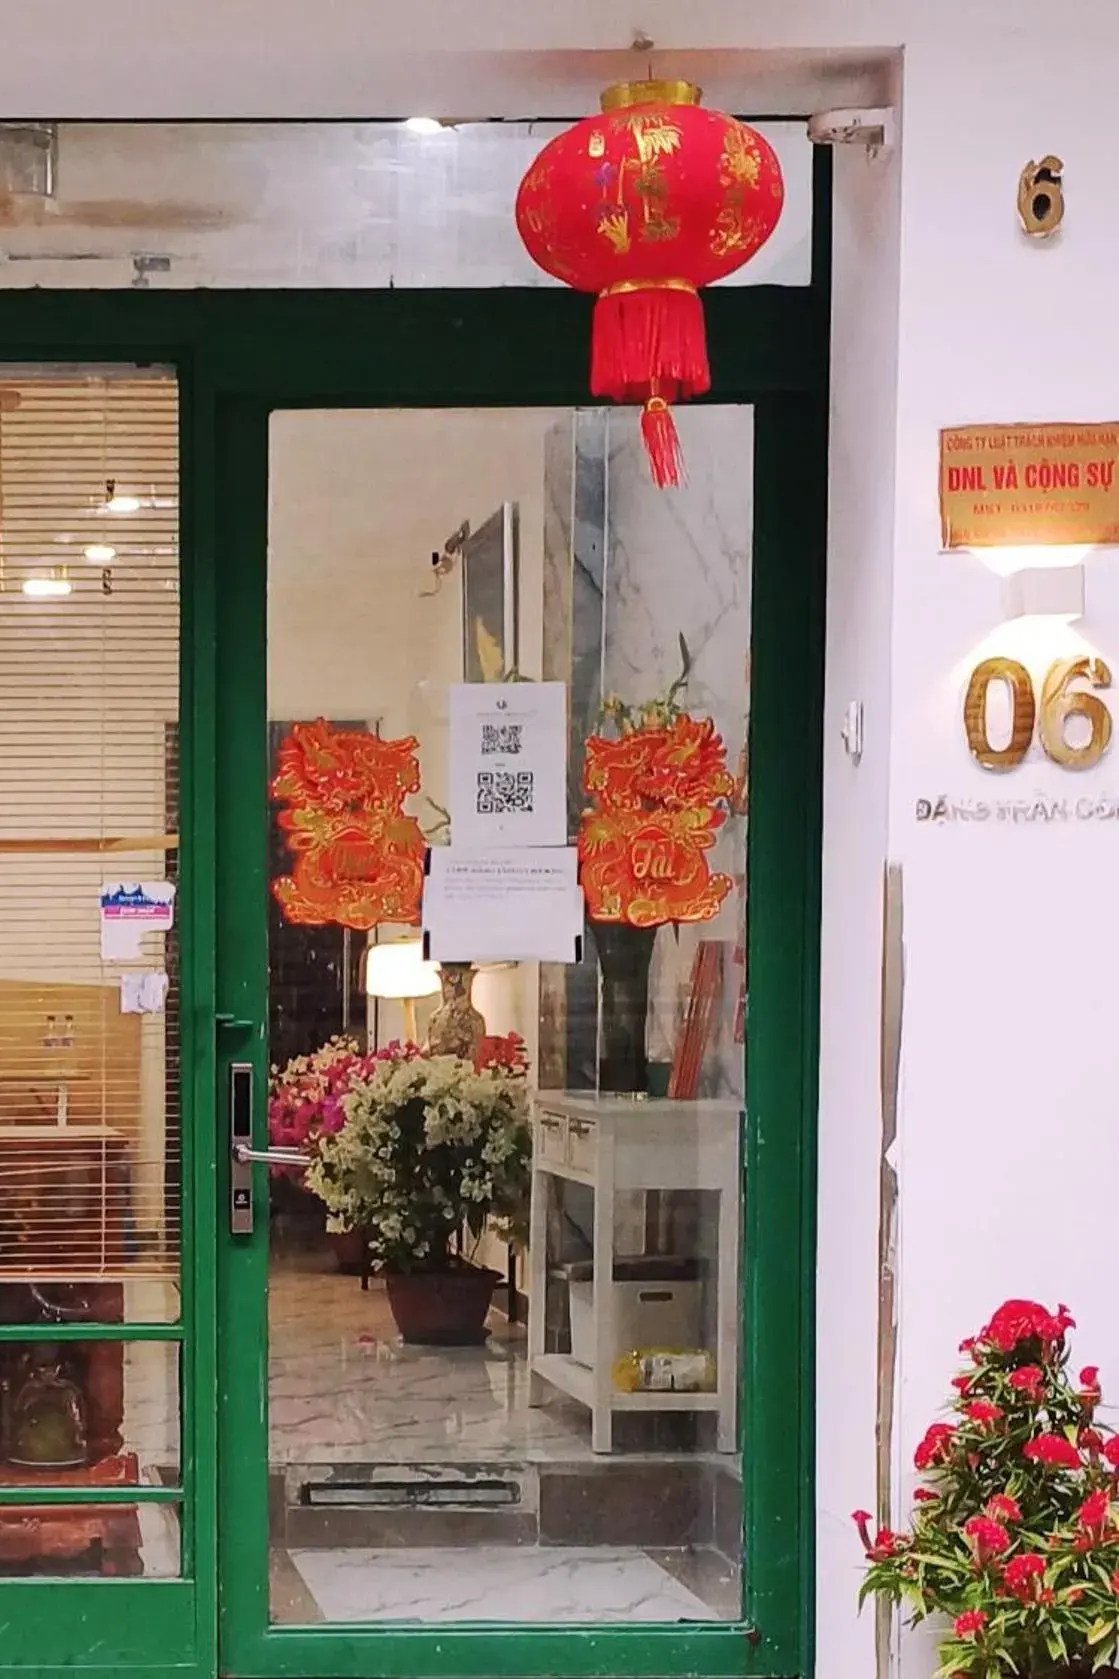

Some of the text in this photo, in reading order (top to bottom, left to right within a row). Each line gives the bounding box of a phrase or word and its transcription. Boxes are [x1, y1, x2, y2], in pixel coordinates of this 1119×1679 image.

[1017, 155, 1066, 238] 6
[948, 465, 987, 492] DNL
[1024, 458, 1080, 493] CỘNG
[1086, 459, 1116, 492] SỰ
[963, 655, 1113, 775] 06
[1075, 790, 1119, 821] CÔ
